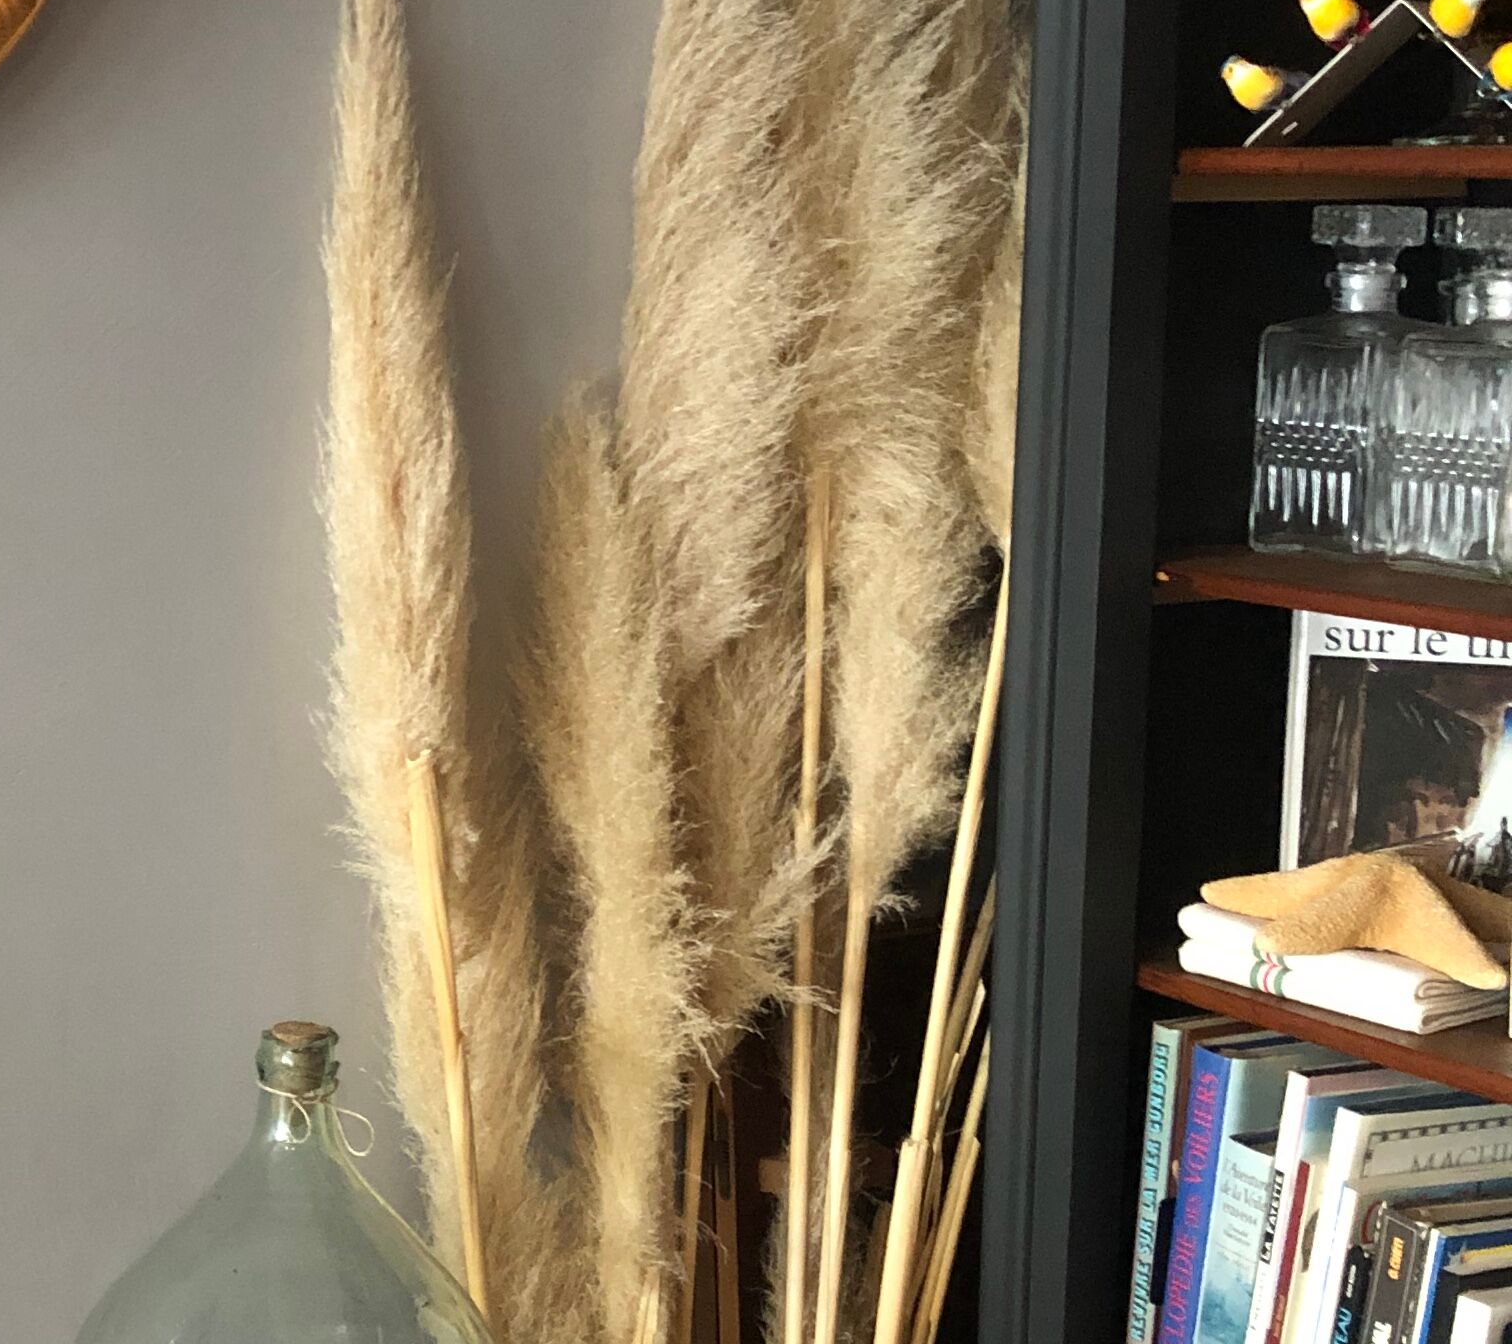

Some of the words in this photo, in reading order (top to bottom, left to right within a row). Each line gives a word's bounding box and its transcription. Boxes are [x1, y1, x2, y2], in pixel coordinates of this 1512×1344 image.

[1324, 625, 1395, 654] sur
[1410, 626, 1448, 657] le
[1184, 1071, 1219, 1184] VOILIERS
[1143, 1139, 1162, 1182] MER
[1410, 1142, 1512, 1172] MACHI
[1141, 1187, 1158, 1214] LA
[1184, 1194, 1202, 1228] DES
[1137, 1218, 1157, 1256] SUR
[1129, 1259, 1150, 1342] REVIVRE
